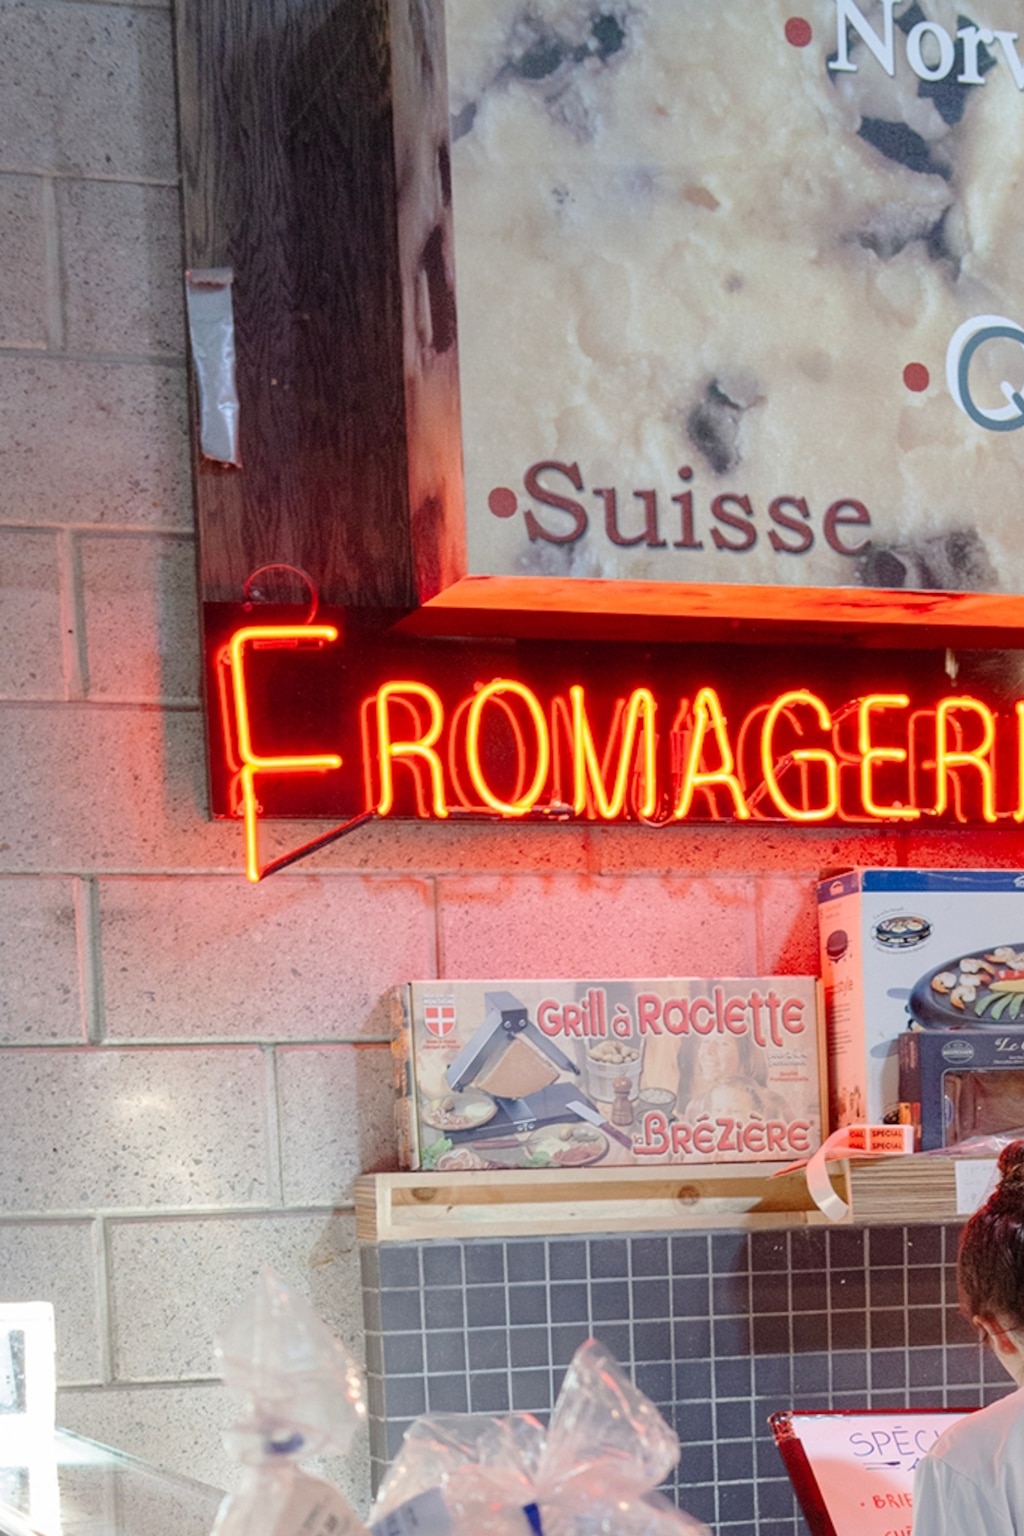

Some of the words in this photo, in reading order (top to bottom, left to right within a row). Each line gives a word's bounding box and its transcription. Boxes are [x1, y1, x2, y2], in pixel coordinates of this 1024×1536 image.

[522, 460, 873, 556] Suisse
[637, 986, 806, 1048] Raclette
[872, 1129, 902, 1137] SPECIAL
[872, 1142, 902, 1150] SPECIAL
